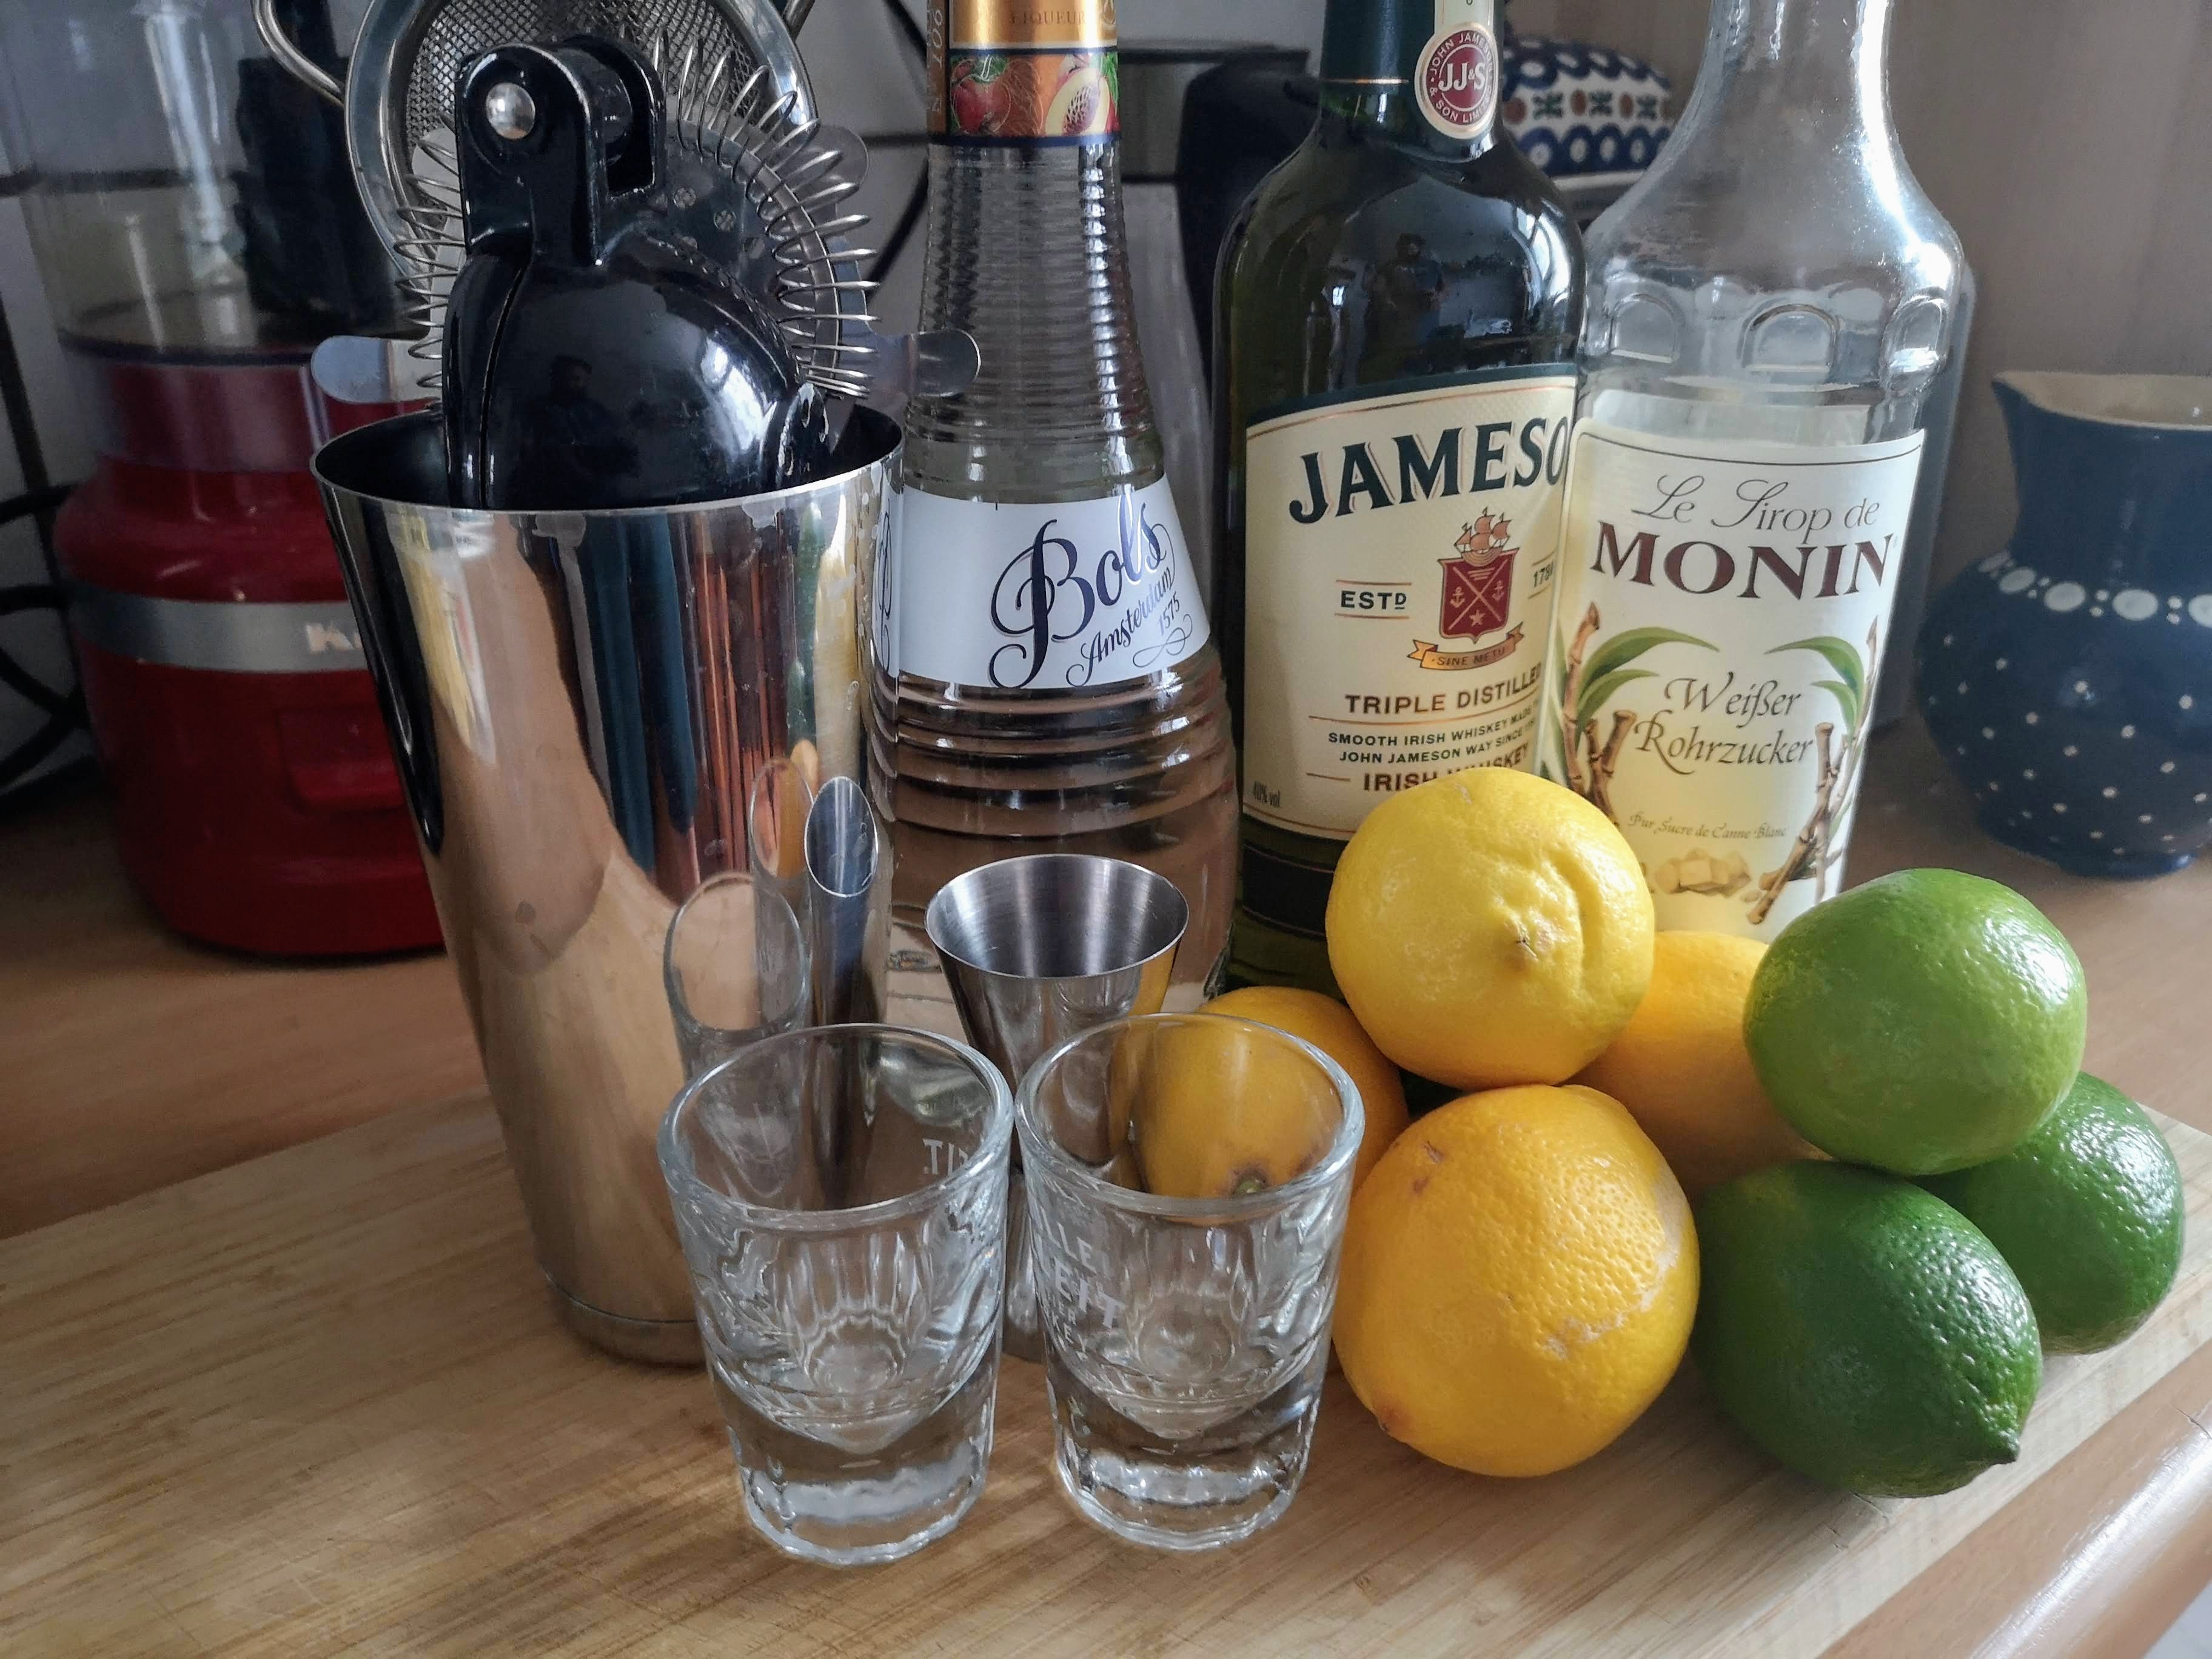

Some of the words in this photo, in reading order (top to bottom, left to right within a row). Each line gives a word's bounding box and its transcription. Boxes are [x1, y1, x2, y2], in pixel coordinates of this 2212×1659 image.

[1430, 39, 1455, 75] JOHN
[1438, 62, 1486, 91] JJ&S
[1435, 99, 1459, 121] SON
[1289, 415, 1569, 525] JAMESO
[1631, 475, 1704, 523] Le
[1711, 479, 1832, 544] Sirop
[1844, 497, 1880, 529] de
[1590, 520, 1894, 600] MONIN
[988, 494, 1175, 689] Bols
[1066, 566, 1174, 686] Amsterdam
[1158, 590, 1180, 635] 1575
[1436, 656, 1470, 666] SINE
[1344, 693, 1446, 715] TRIPLE
[1664, 671, 1802, 728] Weißer
[1329, 732, 1398, 746] SMOOTH
[1404, 733, 1446, 746] IRISH
[1452, 719, 1509, 741] WHISKEY
[1339, 751, 1382, 764] JOHN
[1388, 748, 1460, 764] JAMESON
[1466, 740, 1493, 756] WAY
[1633, 709, 1815, 776] Rohrzucker
[1627, 811, 1655, 828] Pur
[1654, 817, 1693, 835] Sucre
[1695, 823, 1709, 837] de
[1712, 823, 1751, 839] Canne
